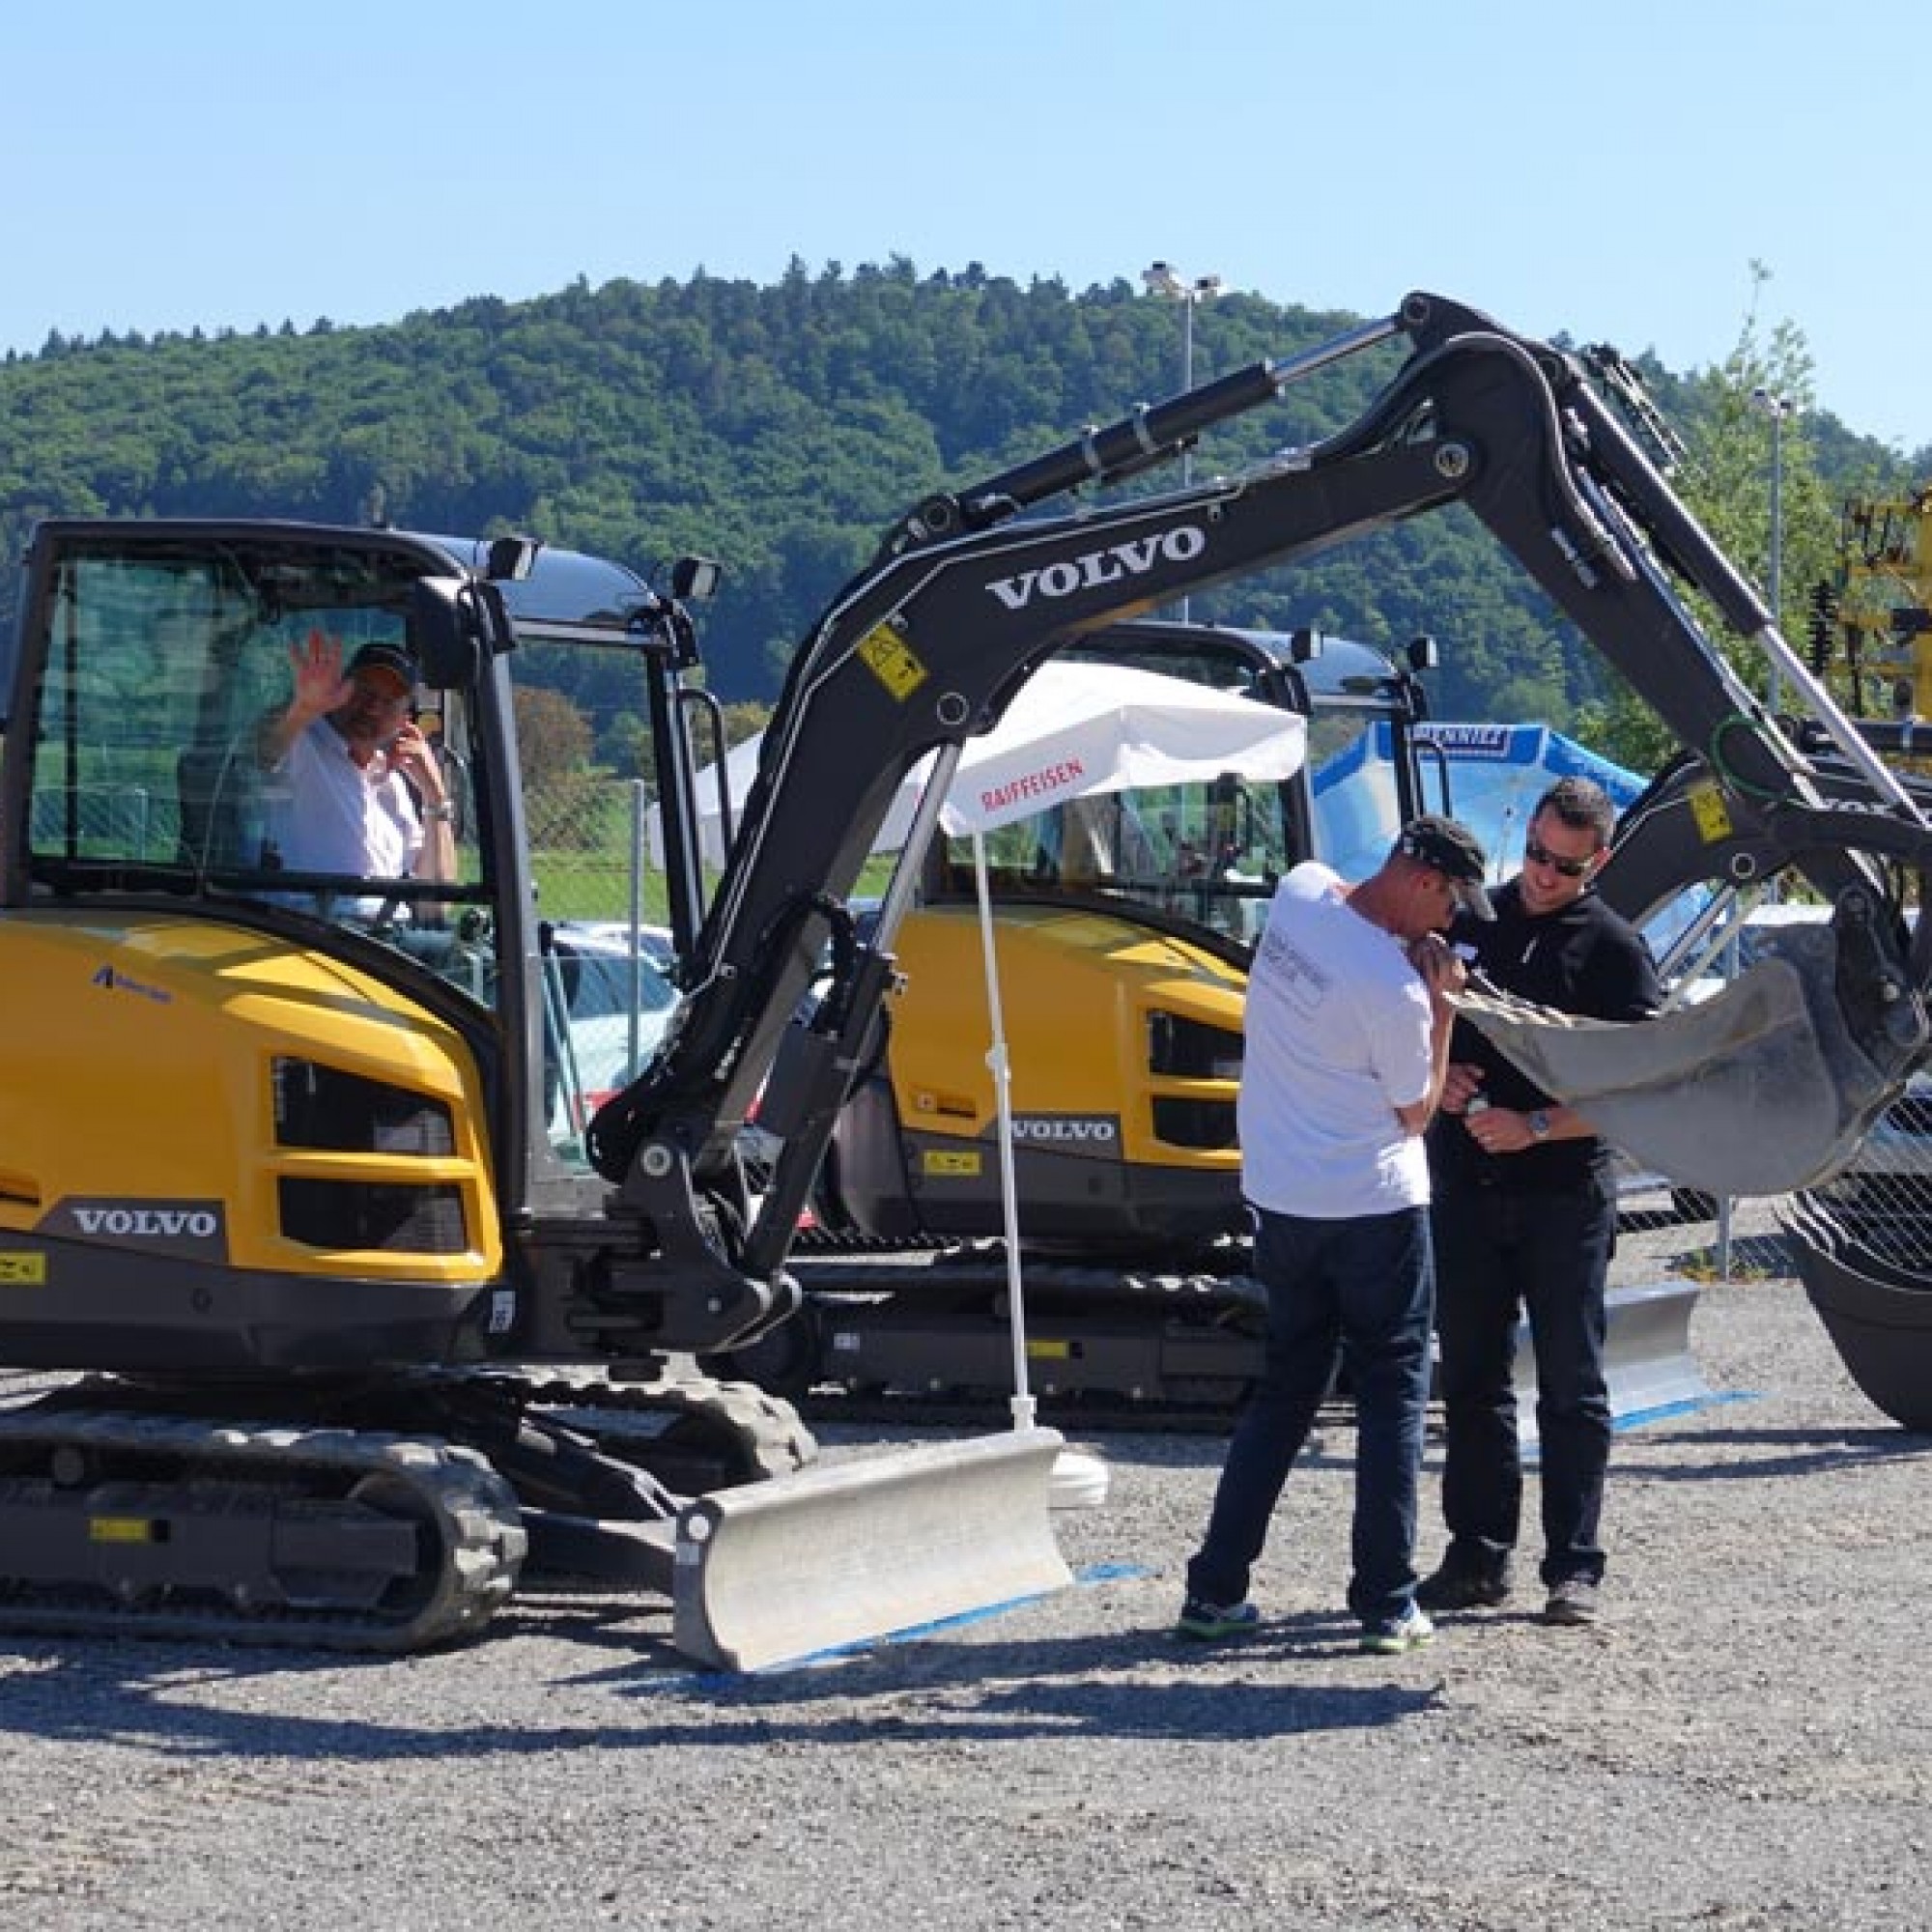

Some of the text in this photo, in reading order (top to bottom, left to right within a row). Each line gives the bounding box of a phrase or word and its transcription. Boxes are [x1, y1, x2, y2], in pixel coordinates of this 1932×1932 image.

[984, 526, 1206, 609] VOLVO
[980, 756, 1083, 812] RAIFFEISEN
[1010, 1121, 1115, 1140] VOLVO
[72, 1209, 216, 1236] VOLVO
